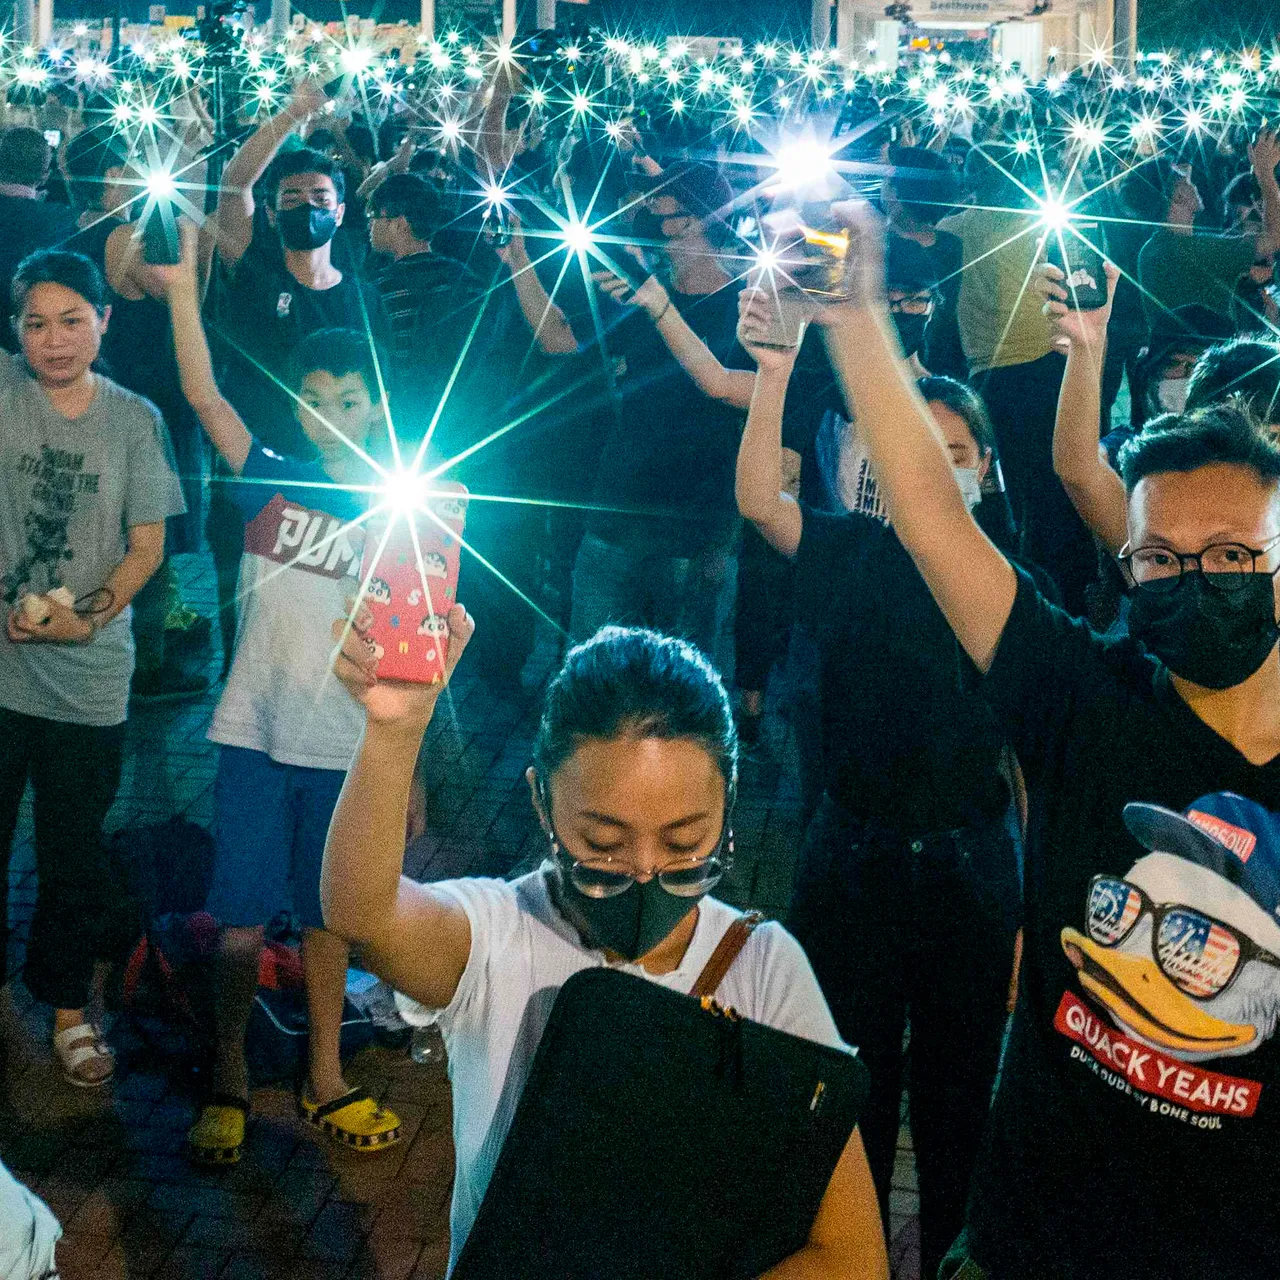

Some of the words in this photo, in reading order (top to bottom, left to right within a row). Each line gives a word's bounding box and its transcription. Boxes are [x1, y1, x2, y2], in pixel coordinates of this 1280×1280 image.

[273, 507, 363, 577] PUM
[1065, 1004, 1151, 1081] QUACK
[1156, 1058, 1250, 1112] YEAHS
[1149, 1098, 1188, 1122] BONE
[1190, 1115, 1222, 1130] SOUL
